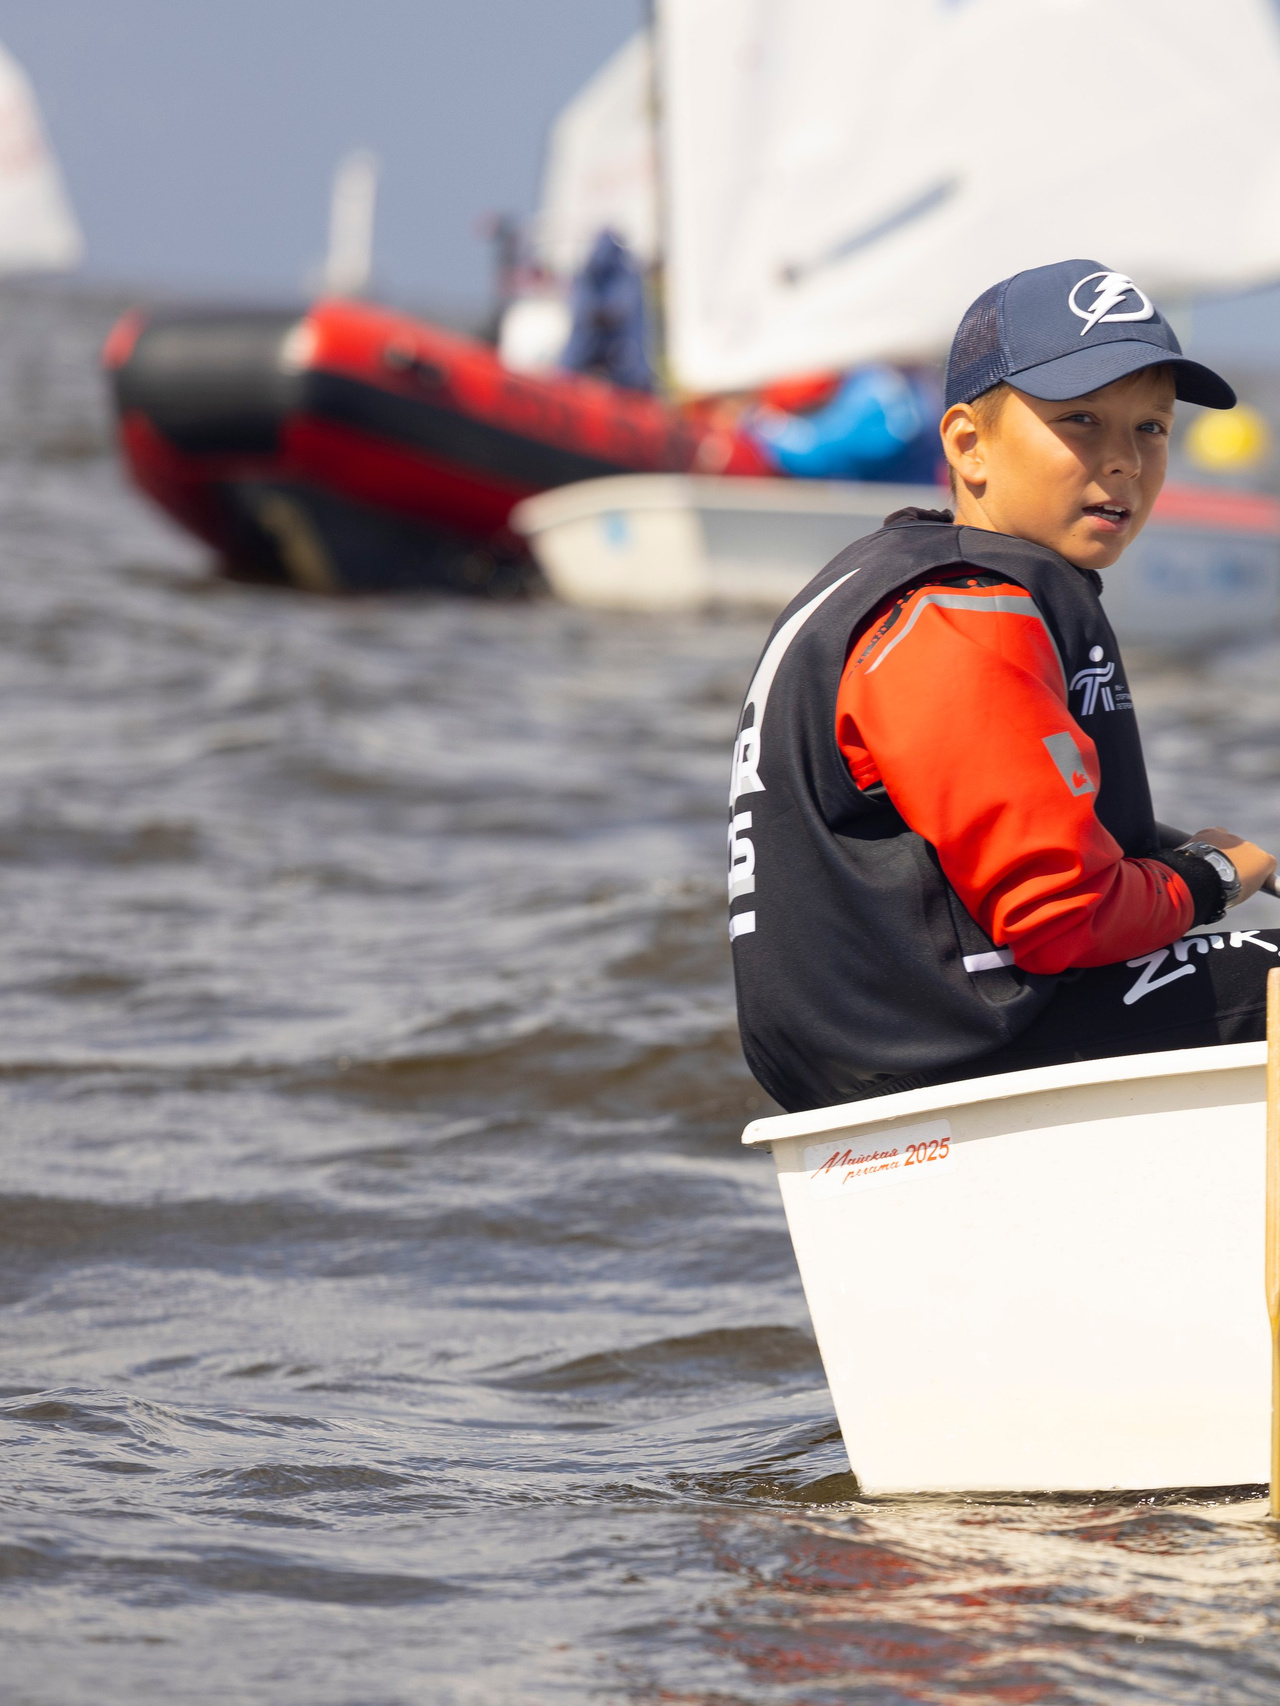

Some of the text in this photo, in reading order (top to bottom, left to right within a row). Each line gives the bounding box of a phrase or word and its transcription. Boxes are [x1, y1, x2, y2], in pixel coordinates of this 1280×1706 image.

[810, 1137, 951, 1179] Майская 2025
[842, 1161, 900, 1185] регата
